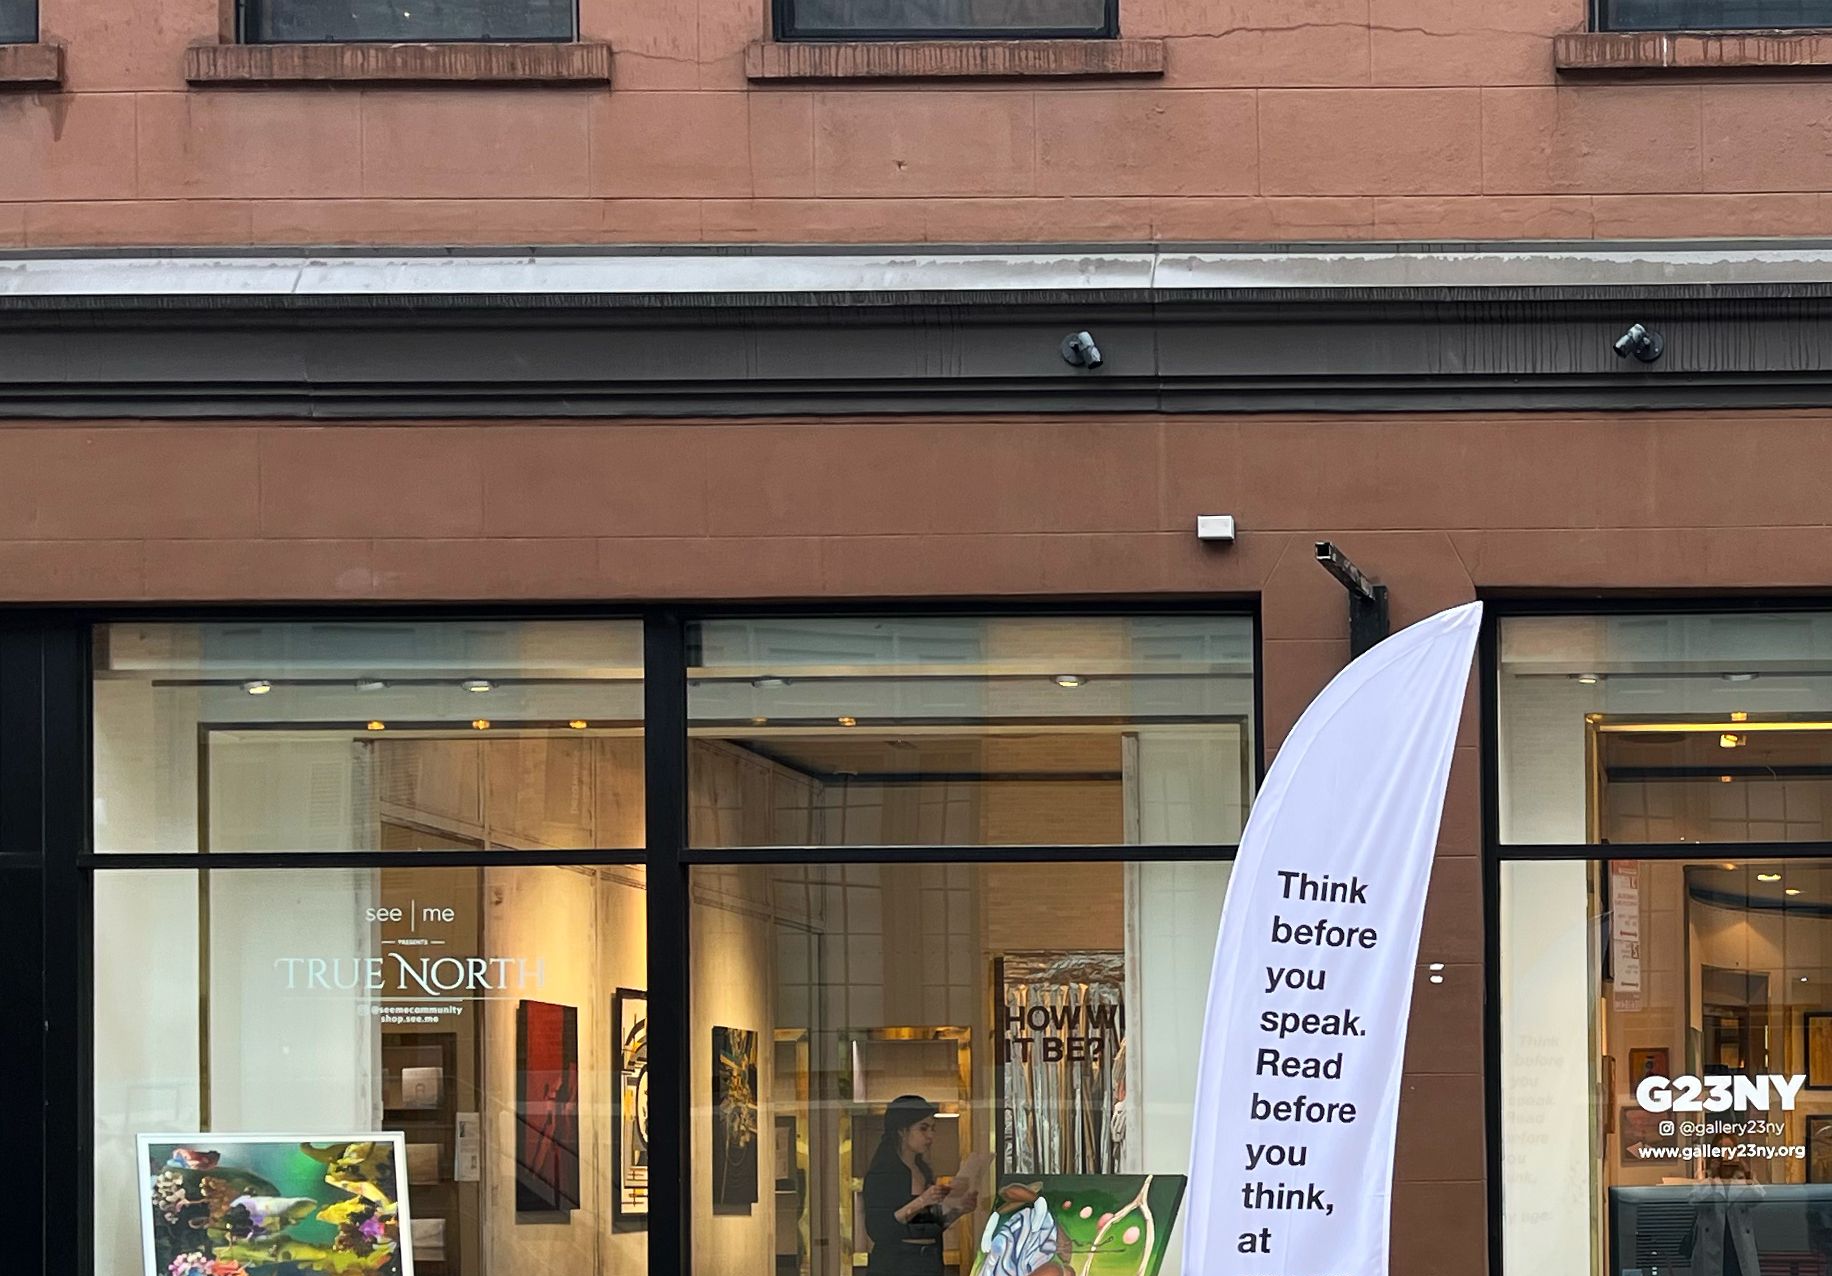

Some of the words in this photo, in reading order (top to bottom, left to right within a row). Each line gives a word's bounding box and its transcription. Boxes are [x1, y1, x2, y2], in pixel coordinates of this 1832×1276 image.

[1277, 870, 1369, 904] Think
[365, 907, 403, 922] see
[422, 907, 455, 922] me
[1271, 915, 1378, 949] before
[274, 957, 386, 990] TRUE
[387, 952, 546, 996] NORTH
[1265, 966, 1326, 994] you
[370, 1005, 463, 1016] @seemecommunity
[380, 1014, 440, 1024] shop.see.me
[1004, 1004, 1081, 1031] HOW
[1260, 1008, 1366, 1039] speak.
[1005, 1037, 1034, 1063] IT
[1042, 1036, 1104, 1063] BE?
[1256, 1048, 1343, 1080] Read
[1636, 1074, 1807, 1113] G23NY
[1250, 1092, 1357, 1124] before
[1679, 1120, 1785, 1137] @gallery23ny
[1245, 1143, 1307, 1171] you
[1638, 1144, 1806, 1161] www.gallery23ny.org
[1241, 1181, 1334, 1216] think,
[1237, 1227, 1272, 1254] at
